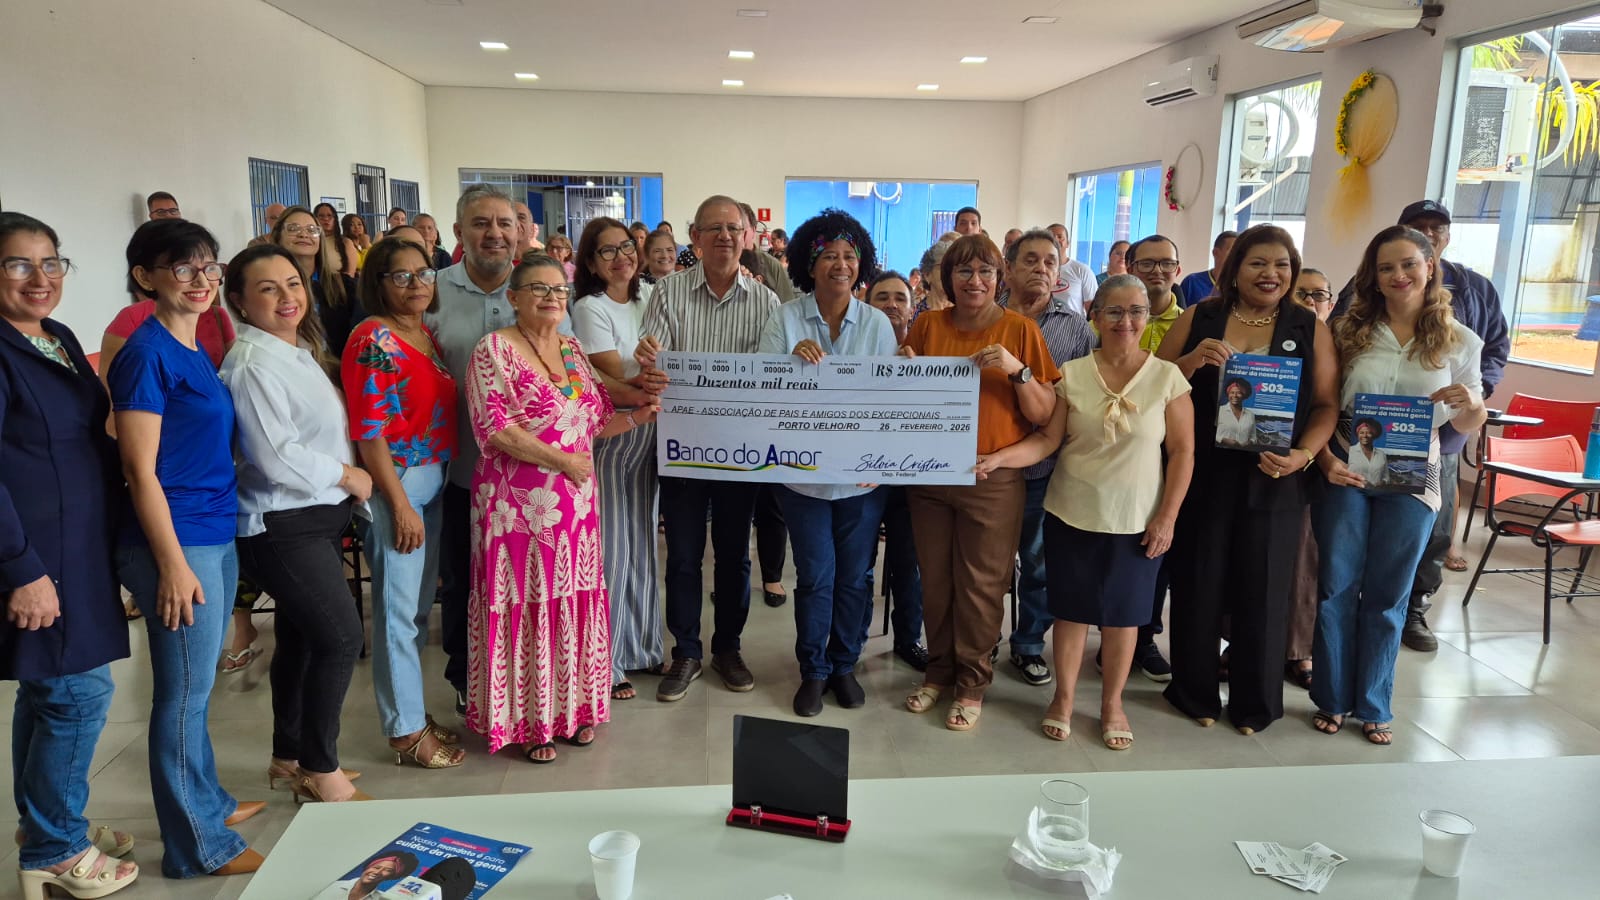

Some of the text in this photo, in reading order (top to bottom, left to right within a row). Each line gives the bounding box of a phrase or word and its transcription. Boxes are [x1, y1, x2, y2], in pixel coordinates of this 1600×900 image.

[667, 362, 680, 370] 000
[712, 364, 730, 372] 0000
[740, 365, 746, 373] 0
[763, 366, 794, 374] 00000-0
[836, 367, 855, 375] 0000
[876, 364, 970, 378] R$ 200.000,00
[696, 374, 756, 389] Duzentos
[760, 377, 783, 390] mil
[786, 378, 819, 390] reais
[671, 405, 694, 415] APAE
[701, 406, 761, 418] ASSOCIAÇÃO
[763, 409, 777, 418] DE
[778, 409, 800, 418] PAIS
[801, 409, 808, 418] E
[809, 409, 847, 419] AMIGOS
[849, 410, 870, 419] DOS
[871, 410, 941, 420] EXCEPCIONAIS
[777, 421, 971, 432] PORTO VELHO/RO 26 FEVEREIRO 2026
[666, 438, 822, 466] Banco do Amor
[899, 454, 951, 473] Cristina
[395, 839, 430, 853] cuidar
[428, 847, 443, 858] da
[474, 858, 507, 873] gente
[436, 843, 476, 858] mandato
[476, 851, 484, 859] é
[482, 854, 506, 865] para
